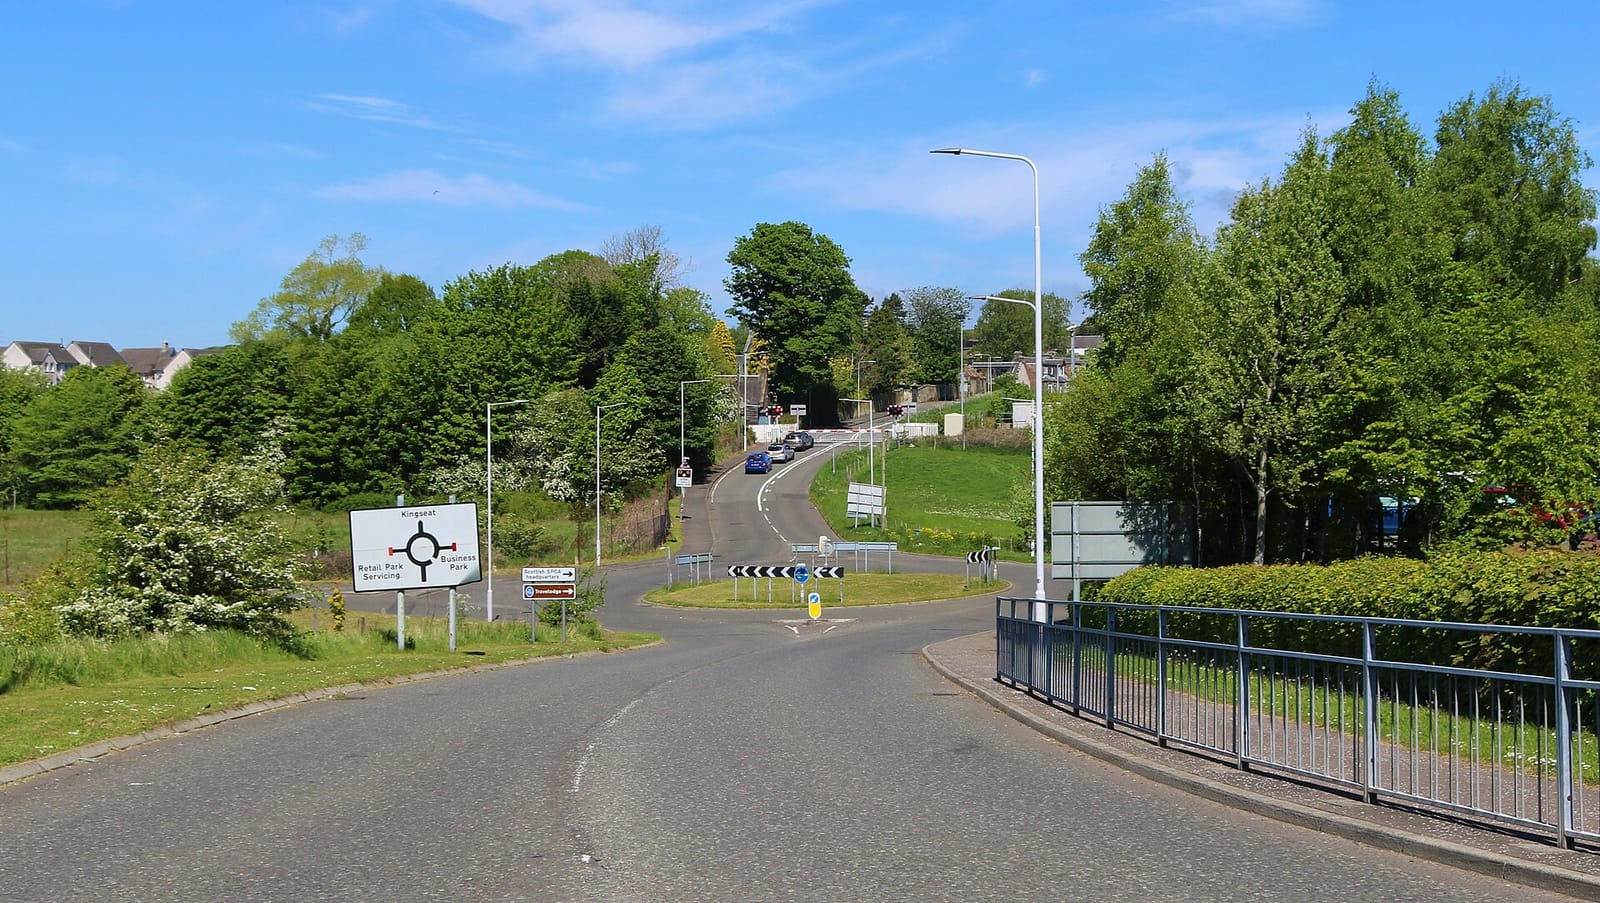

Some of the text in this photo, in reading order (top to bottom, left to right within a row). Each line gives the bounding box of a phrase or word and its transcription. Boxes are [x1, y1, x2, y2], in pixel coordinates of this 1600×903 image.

[401, 510, 436, 518] Kingseat
[440, 554, 476, 563] Business
[358, 564, 382, 572] Retail
[450, 563, 468, 571] Park
[363, 572, 401, 581] Servicing
